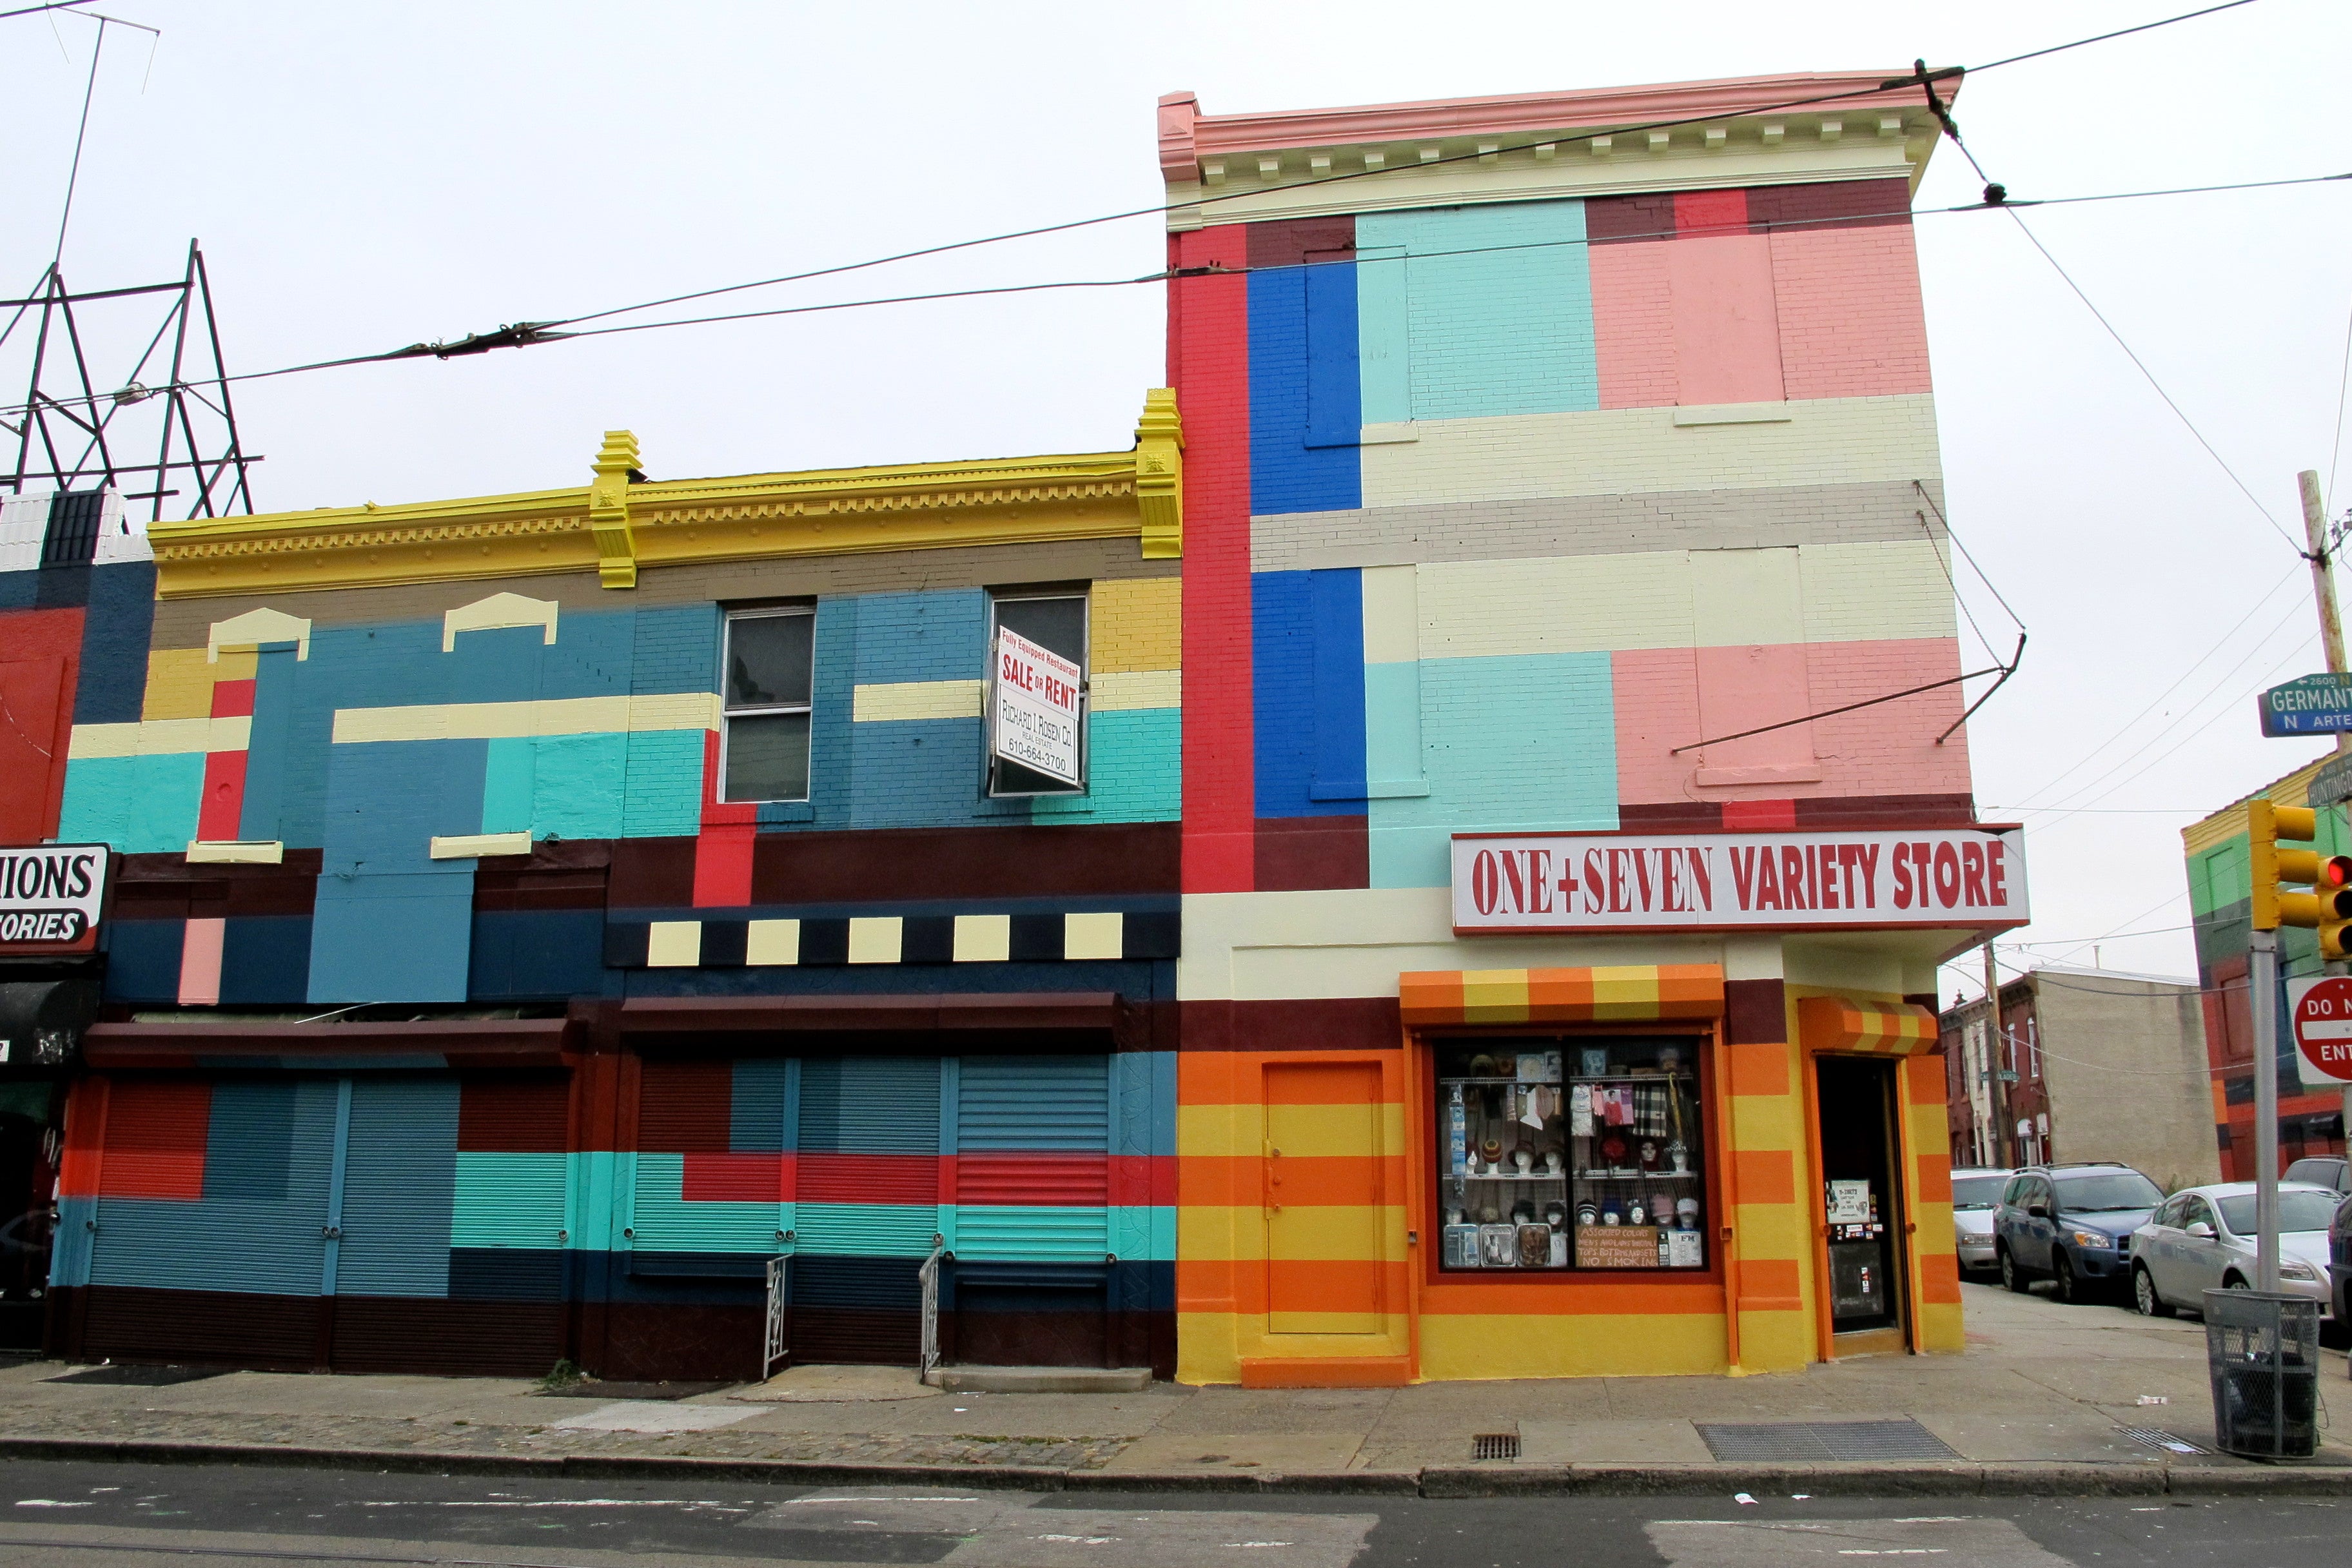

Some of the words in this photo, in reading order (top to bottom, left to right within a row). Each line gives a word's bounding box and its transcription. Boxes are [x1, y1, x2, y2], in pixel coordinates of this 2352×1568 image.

[1003, 631, 1017, 649] Fully
[1019, 638, 1045, 662] Equipped
[1046, 654, 1078, 678] Restaurant
[1003, 654, 1034, 692] SALE
[1035, 675, 1043, 691] OR
[1045, 674, 1076, 712] RENT
[2310, 677, 2336, 685] 2600
[1003, 699, 1032, 730] RICHARD
[1039, 714, 1061, 743] ROSEN
[2284, 714, 2298, 729] N
[1021, 730, 1035, 743] REAL
[1035, 736, 1053, 750] ESTATE
[1008, 738, 1066, 772] 610-664-3700
[1729, 843, 1880, 911] VARIETY
[1892, 840, 2008, 910] STORE
[2307, 999, 2333, 1015] DO
[1581, 1227, 1621, 1237] ASSORTED
[1583, 1257, 1600, 1266] NO
[1607, 1257, 1658, 1266] SMOKING
